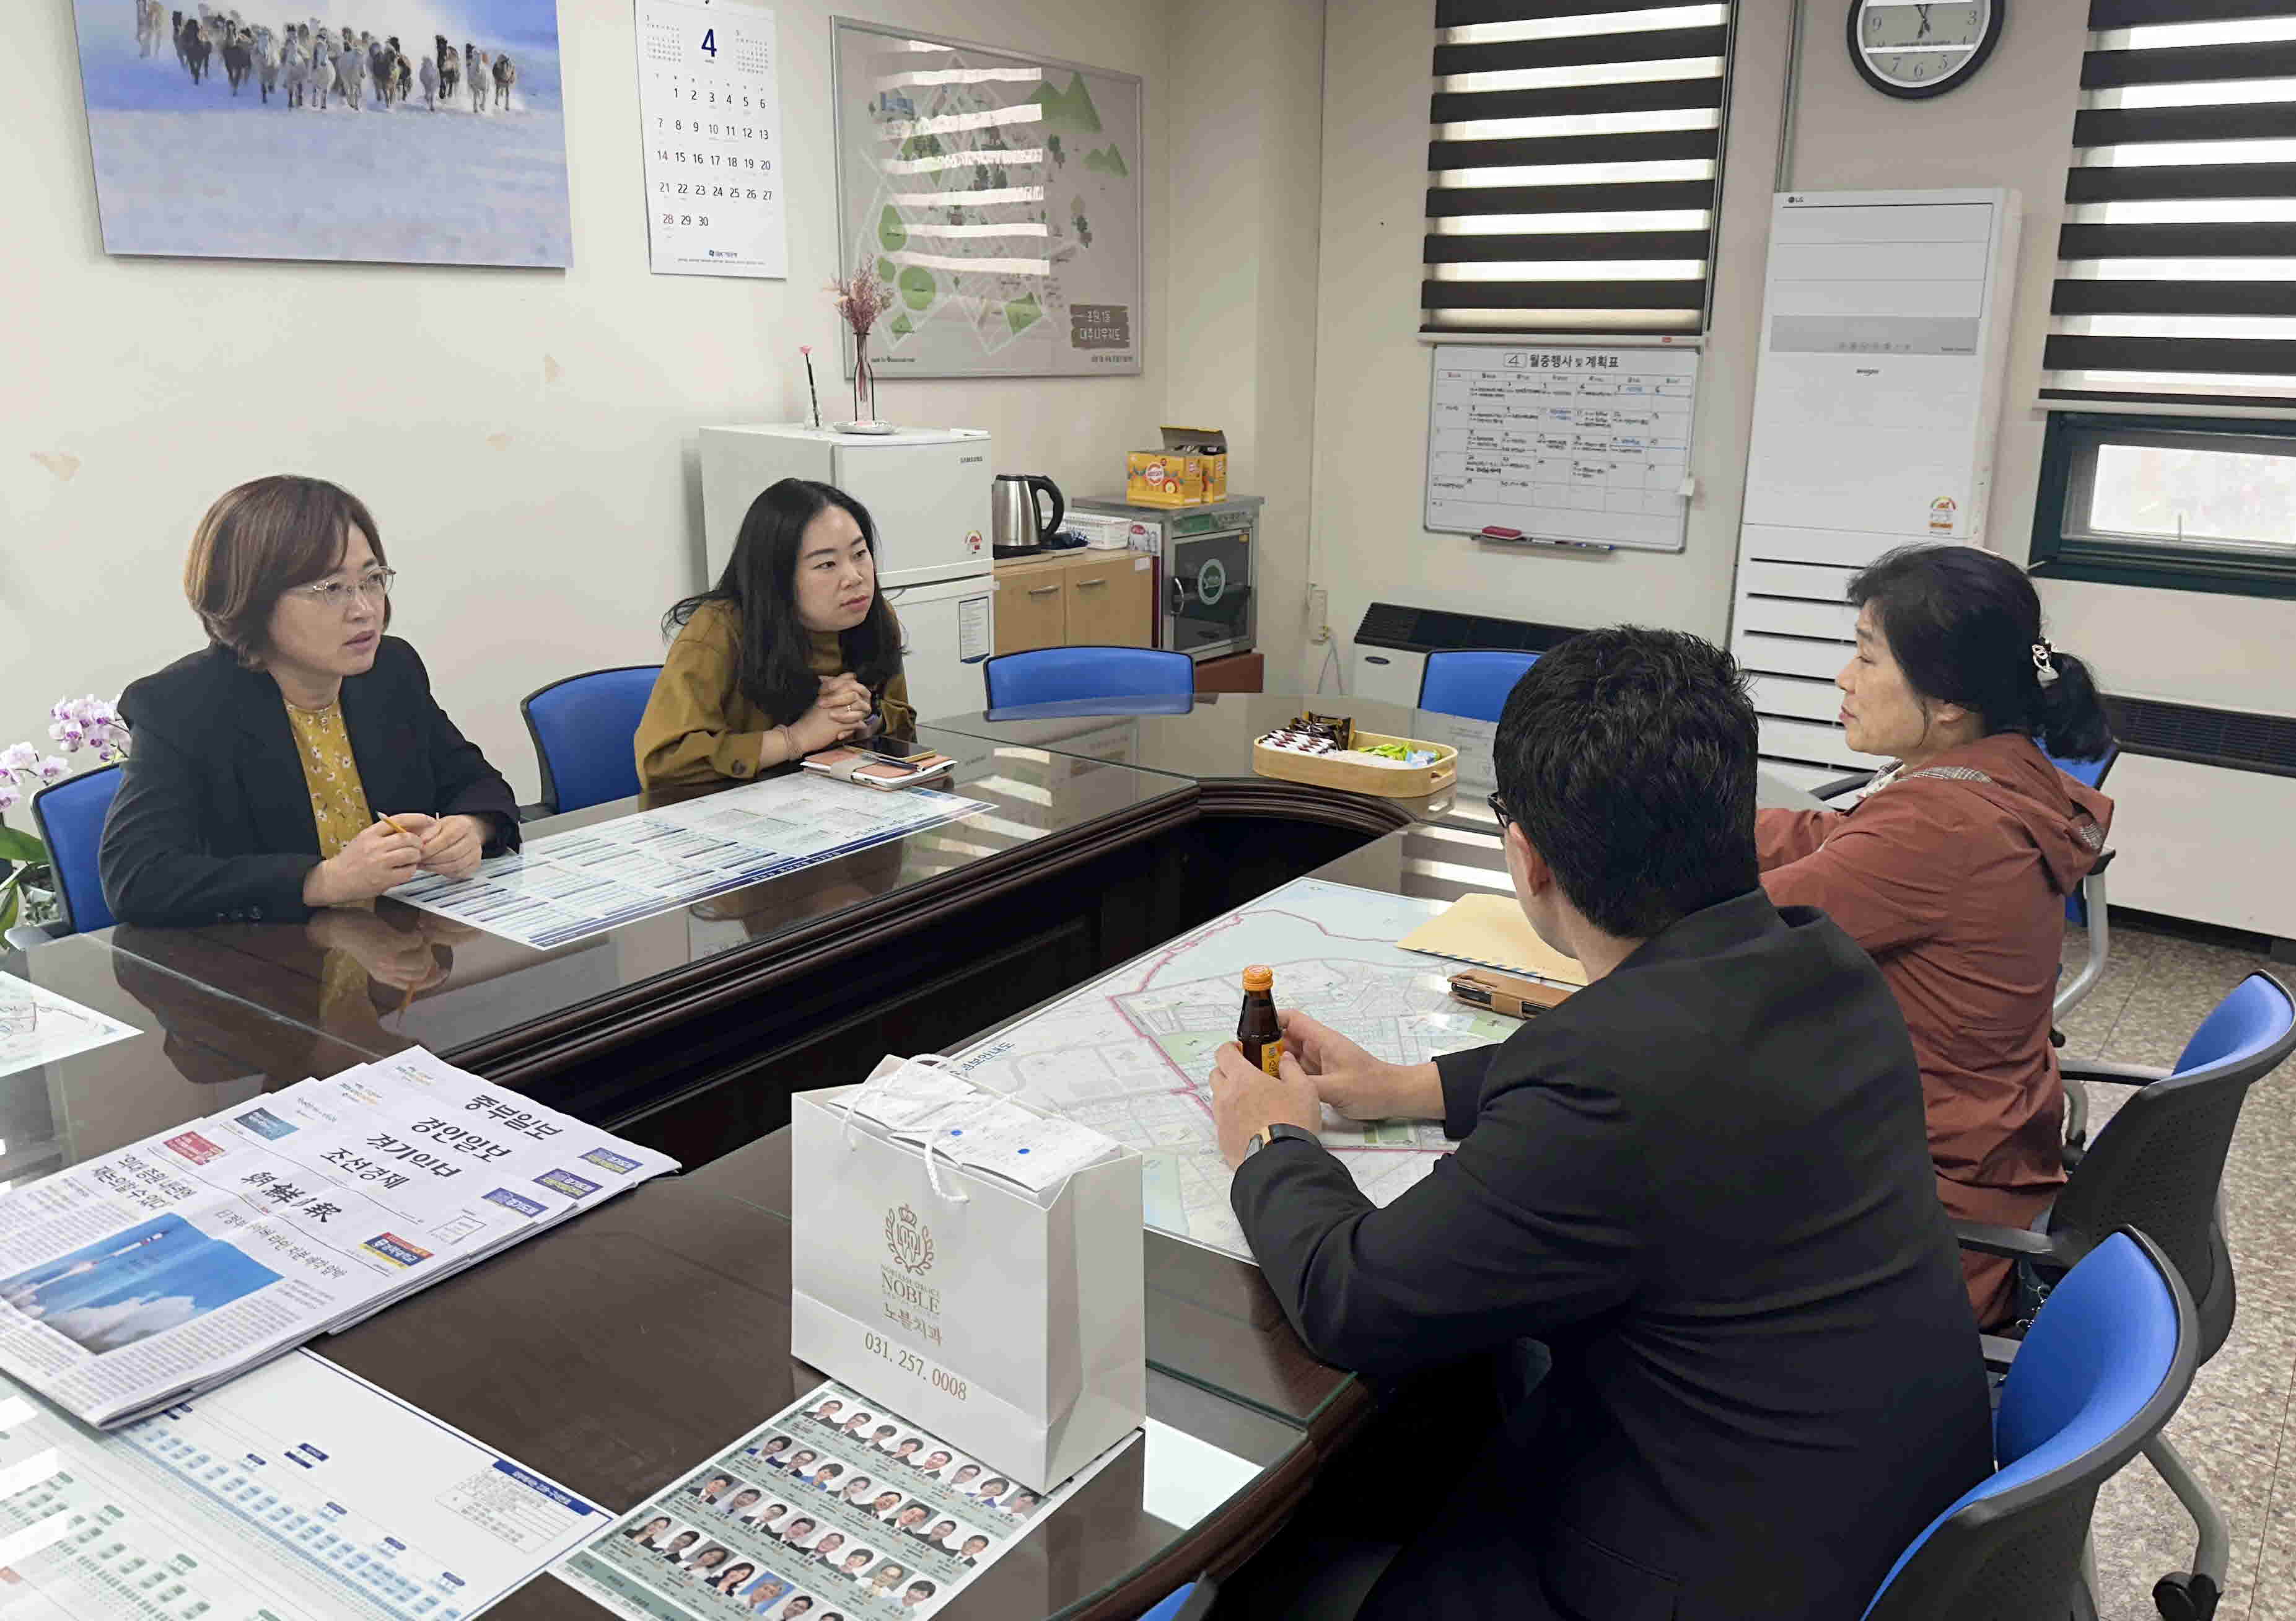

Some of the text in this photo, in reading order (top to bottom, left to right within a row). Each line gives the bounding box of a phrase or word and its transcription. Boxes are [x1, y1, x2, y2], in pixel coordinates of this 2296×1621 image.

[701, 29, 717, 57] 4
[675, 88, 766, 108] 1 2 3 4 5 6
[659, 118, 768, 139] 7 8 9 10 11 12 13
[658, 151, 771, 170] 14 15 16 17 18 19 20
[659, 182, 773, 200] 21 22 23 24 25 26 27
[664, 214, 708, 226] 28 29 30
[1507, 354, 1619, 369] 4 월중행사 및 계획표
[465, 1094, 563, 1140] 중부일보
[411, 1116, 512, 1162] 경인일보
[320, 1147, 410, 1190] 조선경제
[366, 1133, 462, 1177] 경기일보
[882, 1272, 940, 1316] NOBLE
[865, 1332, 967, 1402] 031. 257. 0008
